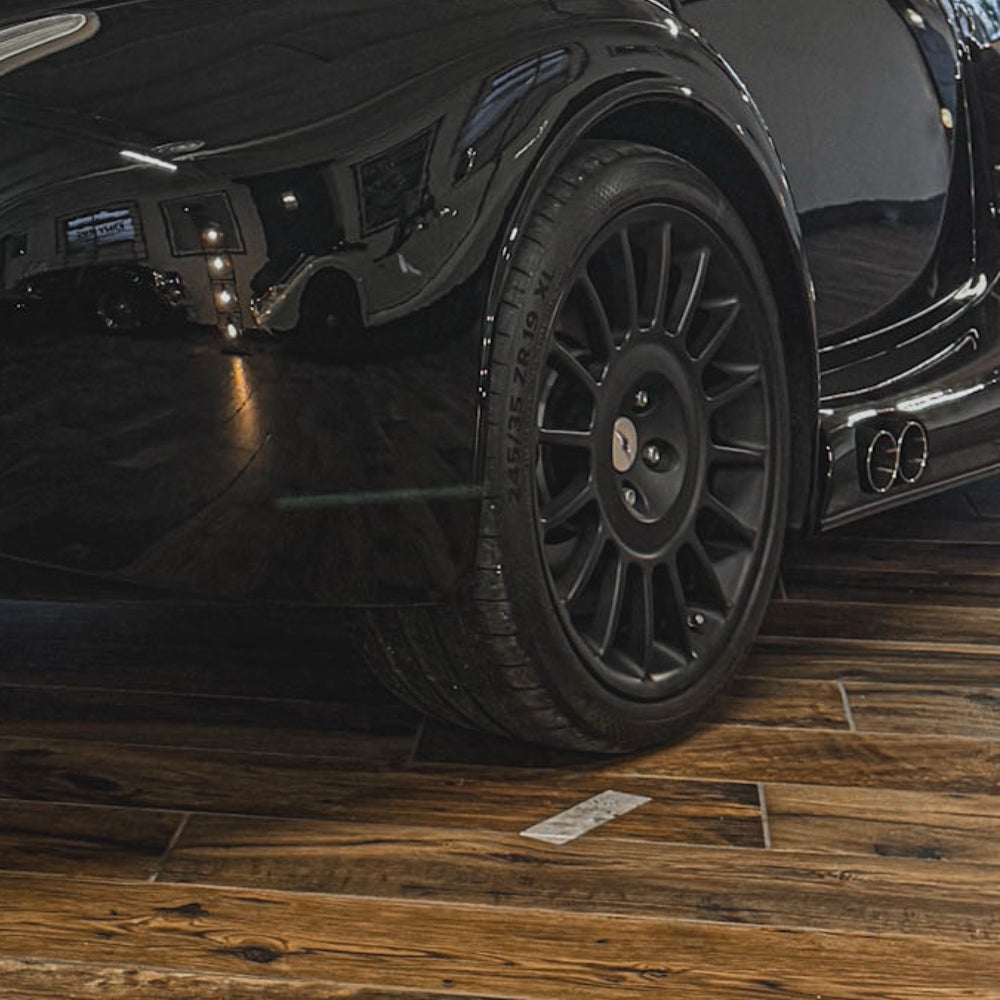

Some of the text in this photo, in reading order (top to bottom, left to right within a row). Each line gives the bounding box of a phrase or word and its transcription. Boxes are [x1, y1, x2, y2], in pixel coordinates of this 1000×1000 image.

[522, 311, 538, 342] 19
[513, 346, 530, 387] ZR
[506, 397, 523, 506] 245/35
